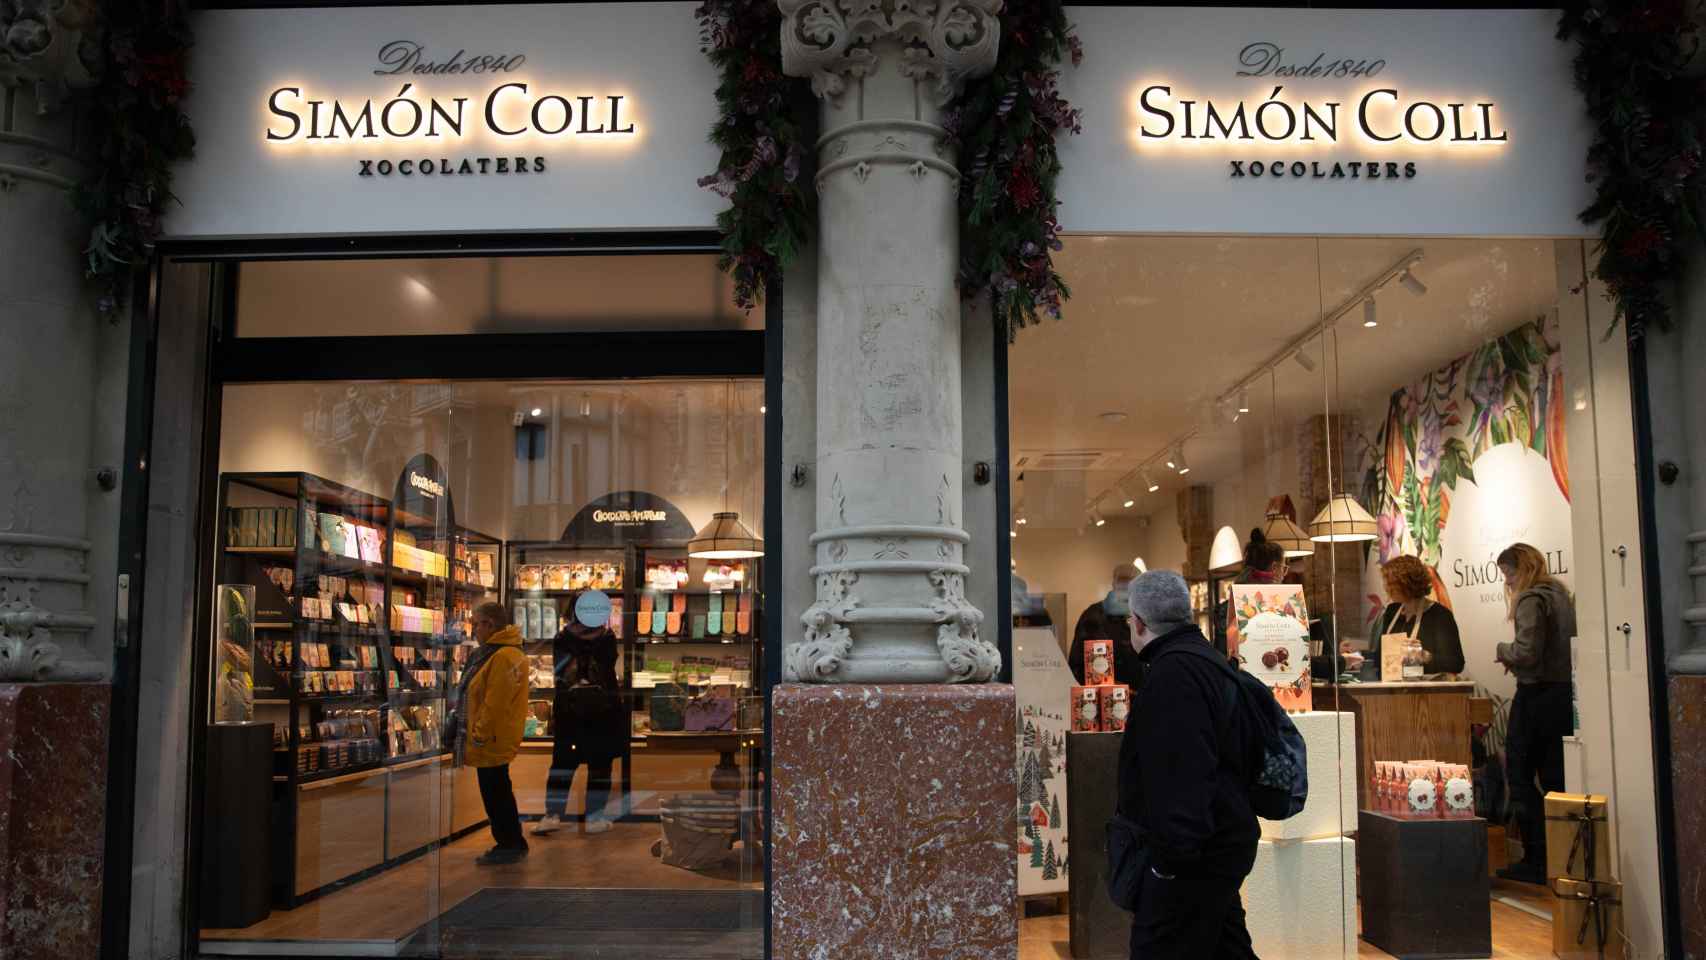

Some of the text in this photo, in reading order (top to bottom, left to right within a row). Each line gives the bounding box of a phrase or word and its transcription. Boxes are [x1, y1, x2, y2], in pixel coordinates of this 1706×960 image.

[266, 83, 635, 140] SIMÓN COLL
[1139, 85, 1508, 142] SIMÓN COLL
[358, 156, 547, 177] XOCOLATERS
[1230, 160, 1418, 179] XOCOLATERS
[1453, 551, 1505, 588] SIMÓ
